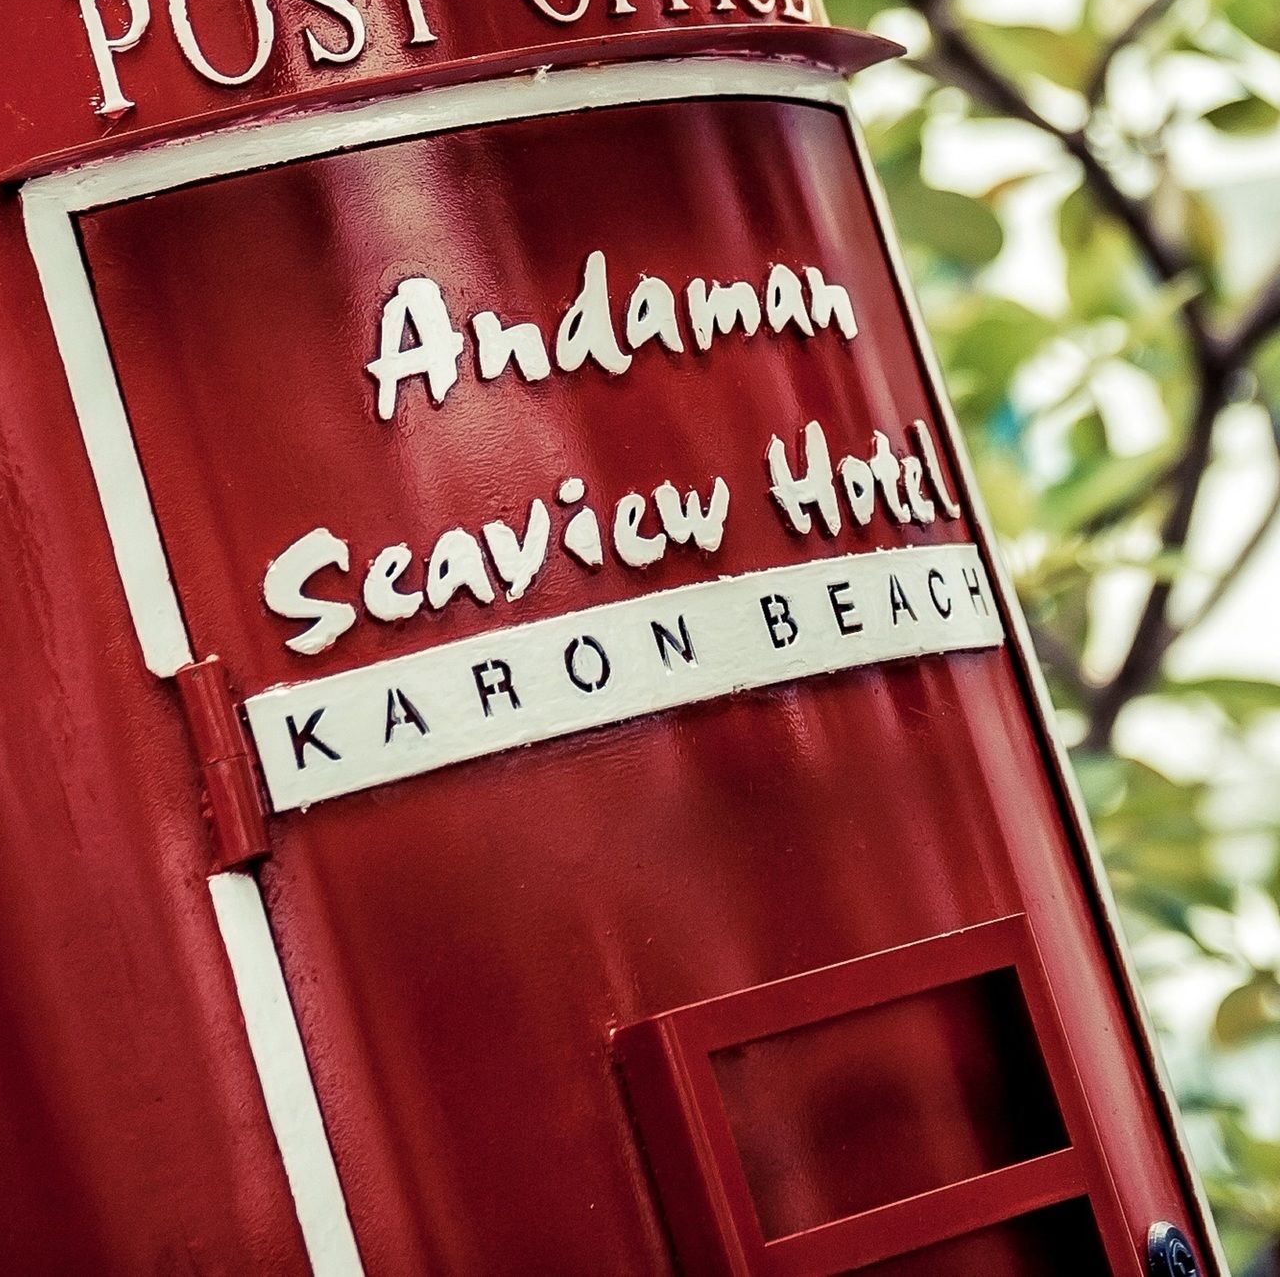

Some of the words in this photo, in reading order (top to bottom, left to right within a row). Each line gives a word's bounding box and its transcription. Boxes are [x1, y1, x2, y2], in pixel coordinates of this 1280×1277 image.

[367, 251, 858, 420] Andaman
[263, 477, 730, 654] Seaview
[767, 420, 960, 536] Hotel
[284, 615, 697, 772] KARON
[764, 566, 990, 650] BEACH
